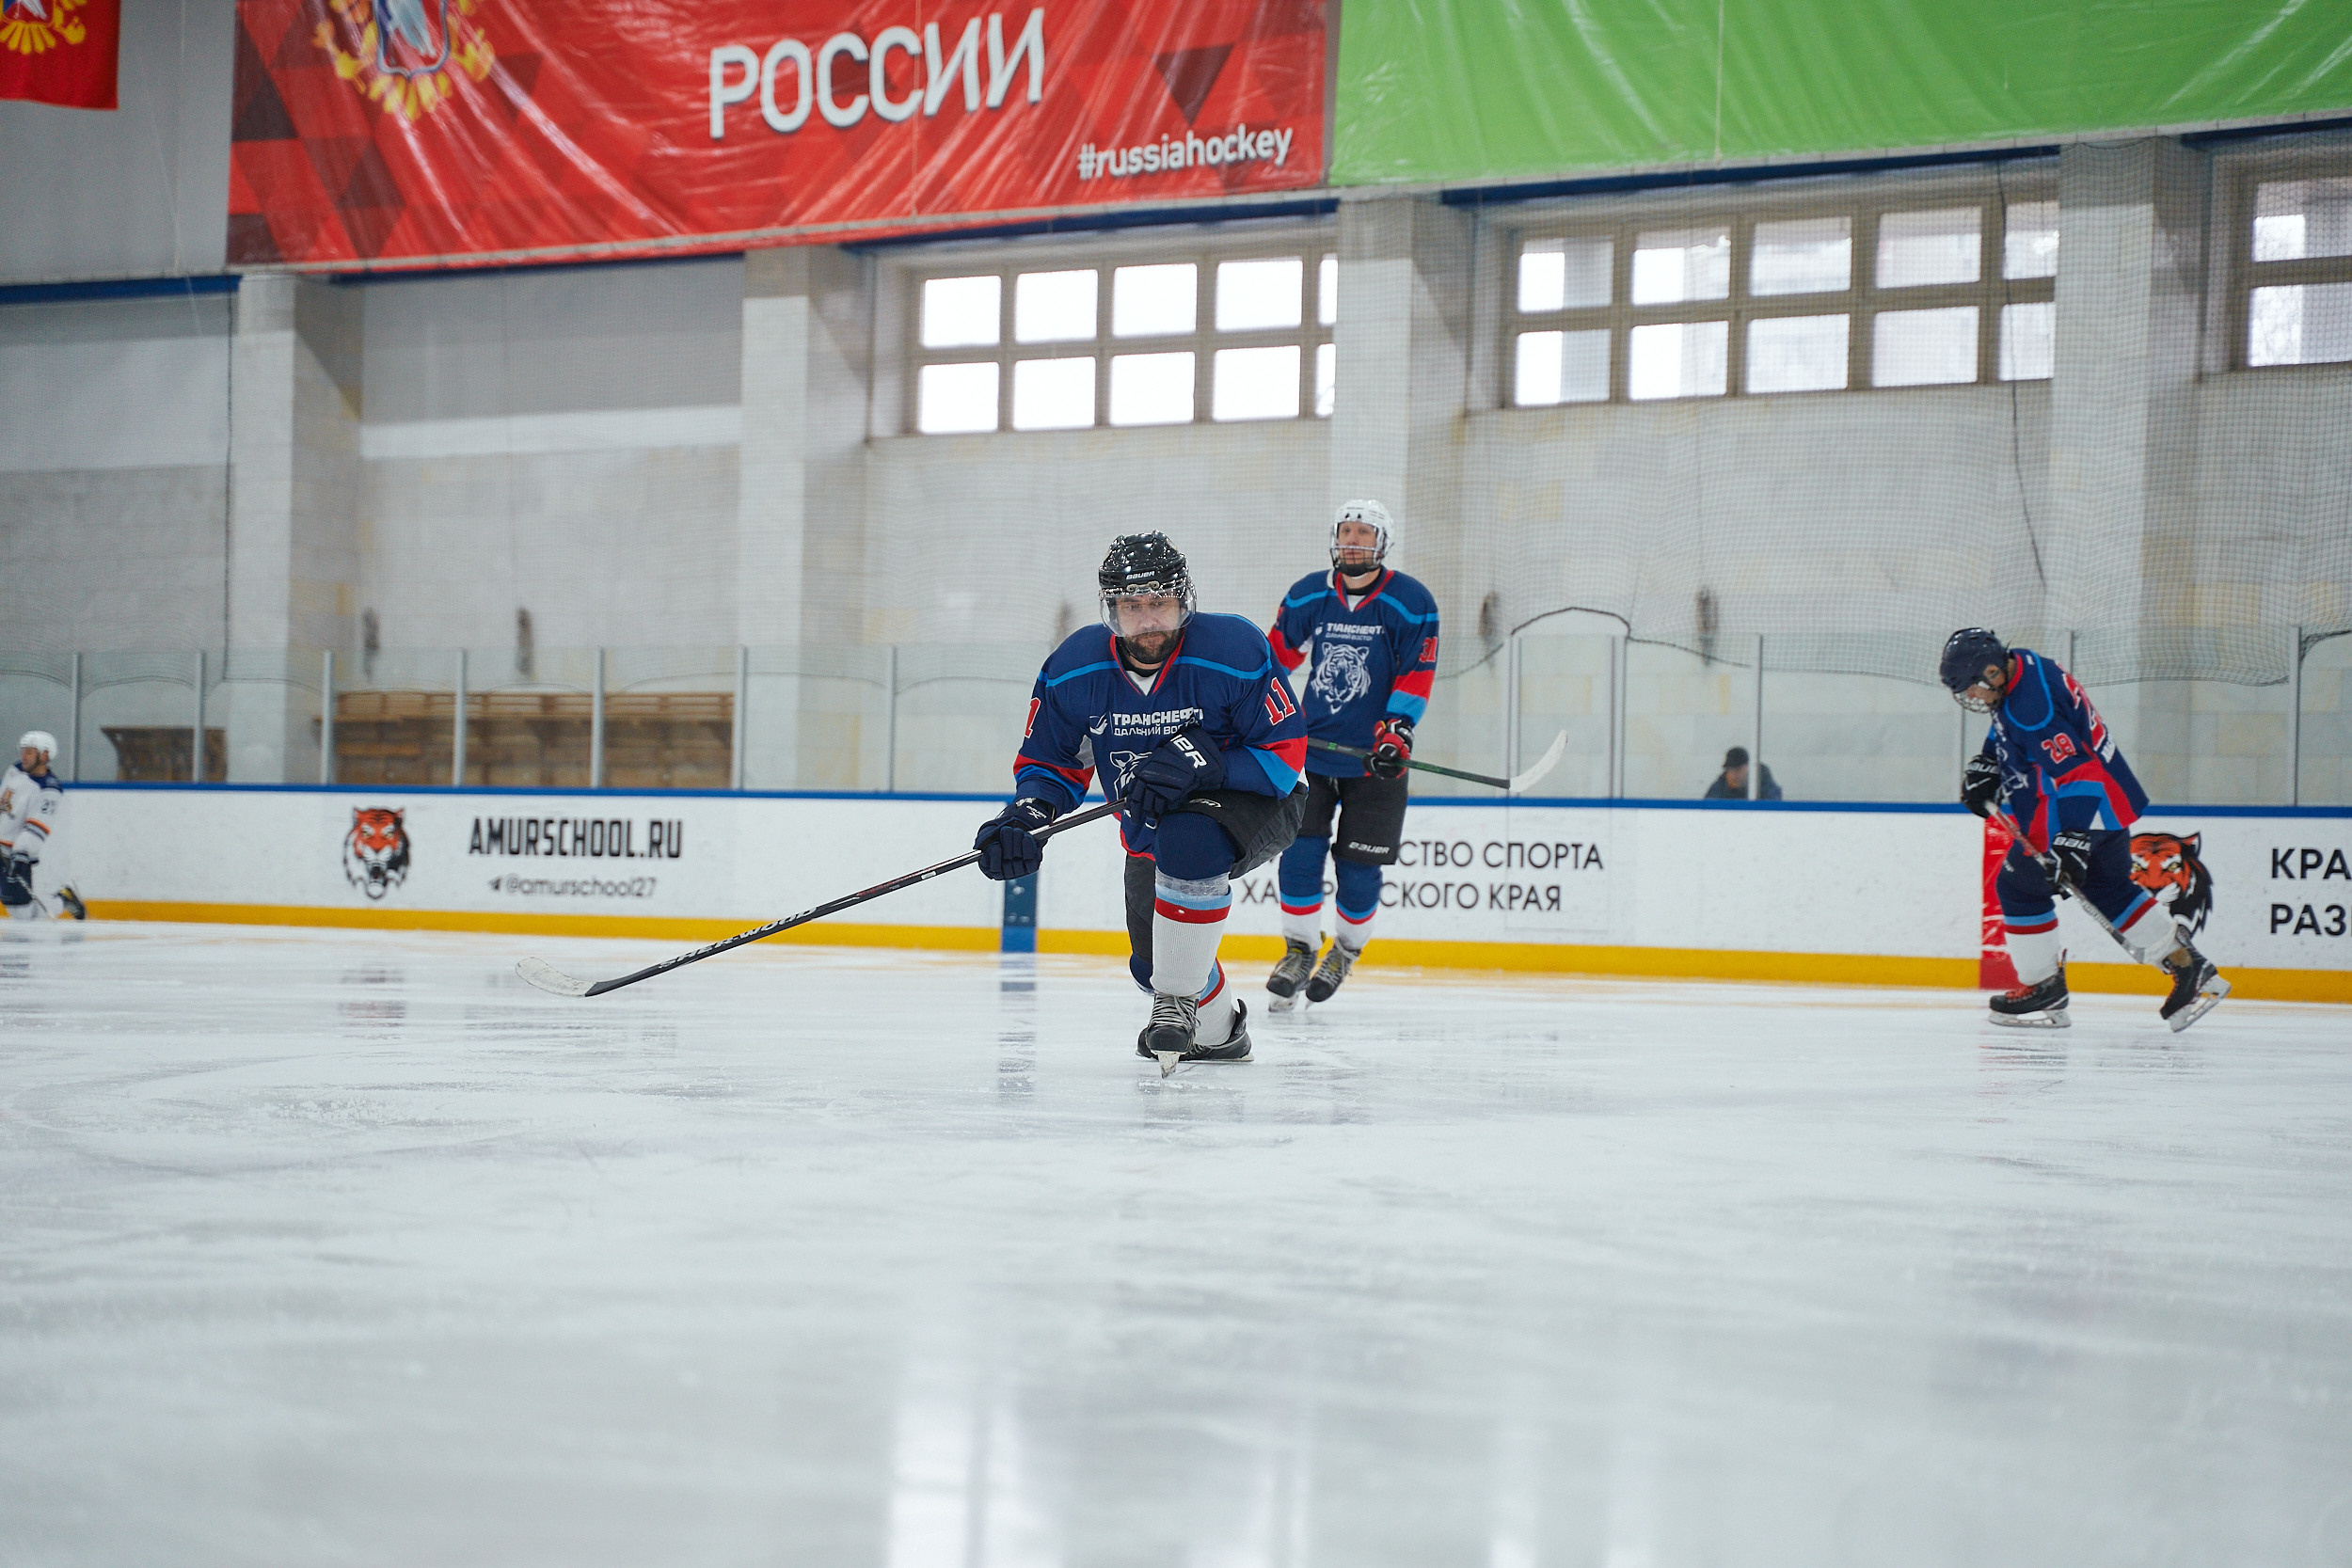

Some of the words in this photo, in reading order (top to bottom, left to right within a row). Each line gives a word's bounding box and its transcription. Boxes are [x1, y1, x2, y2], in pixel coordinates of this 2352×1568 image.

[709, 8, 1044, 139] РОССИИ
[1077, 123, 1294, 180] #russiahockey
[1126, 571, 1155, 580] BAUER
[1419, 636, 1438, 662] 31
[1265, 677, 1296, 726] 11
[1114, 722, 1161, 736] ДАЛЬНИЙ
[2041, 733, 2076, 764] 28
[469, 817, 683, 859] AMURSCHOOL.RU
[1348, 841, 1391, 854] BAUER
[1398, 841, 1473, 867] СТВО
[1483, 841, 1603, 869] СПОРТА
[506, 873, 657, 896] @amurschool27
[1489, 883, 1561, 911] КРАЯ
[2270, 903, 2352, 937] РАЗ
